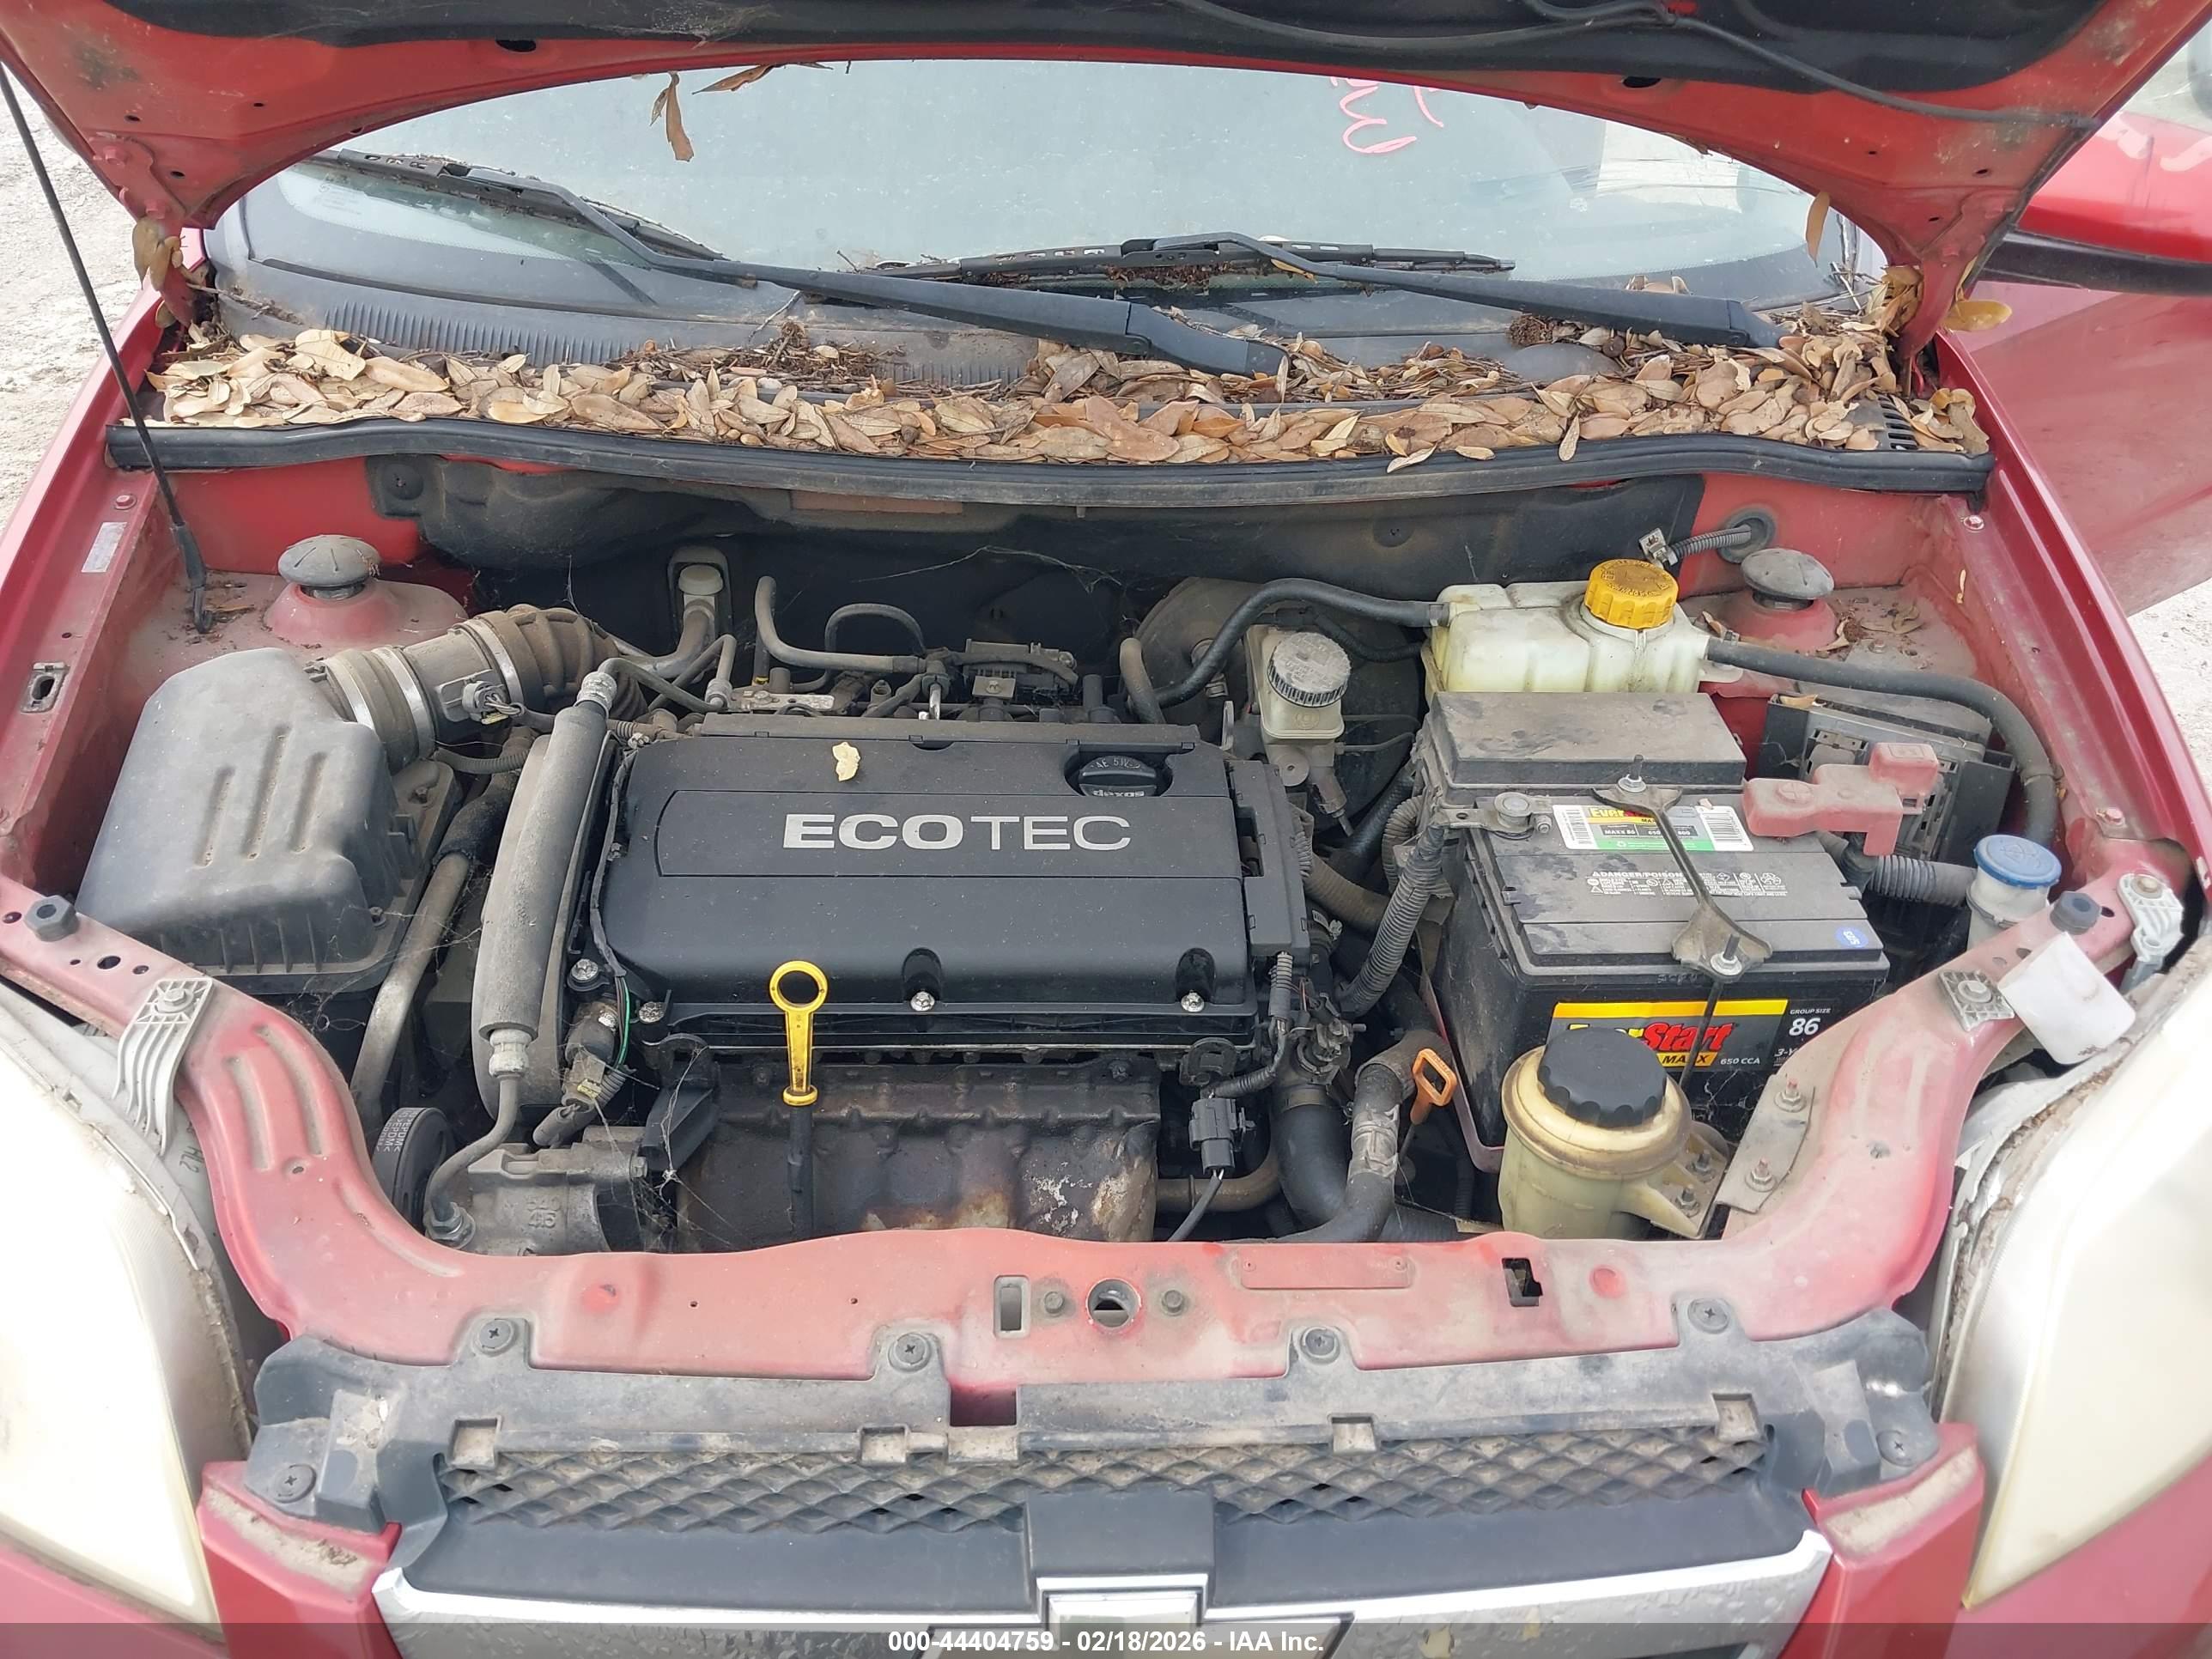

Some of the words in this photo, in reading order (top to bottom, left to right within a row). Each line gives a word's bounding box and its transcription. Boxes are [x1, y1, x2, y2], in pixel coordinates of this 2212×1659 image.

[783, 813, 1131, 851] ECOTEC
[1789, 1018, 1820, 1036] 86
[1662, 1055, 1709, 1064] MAX
